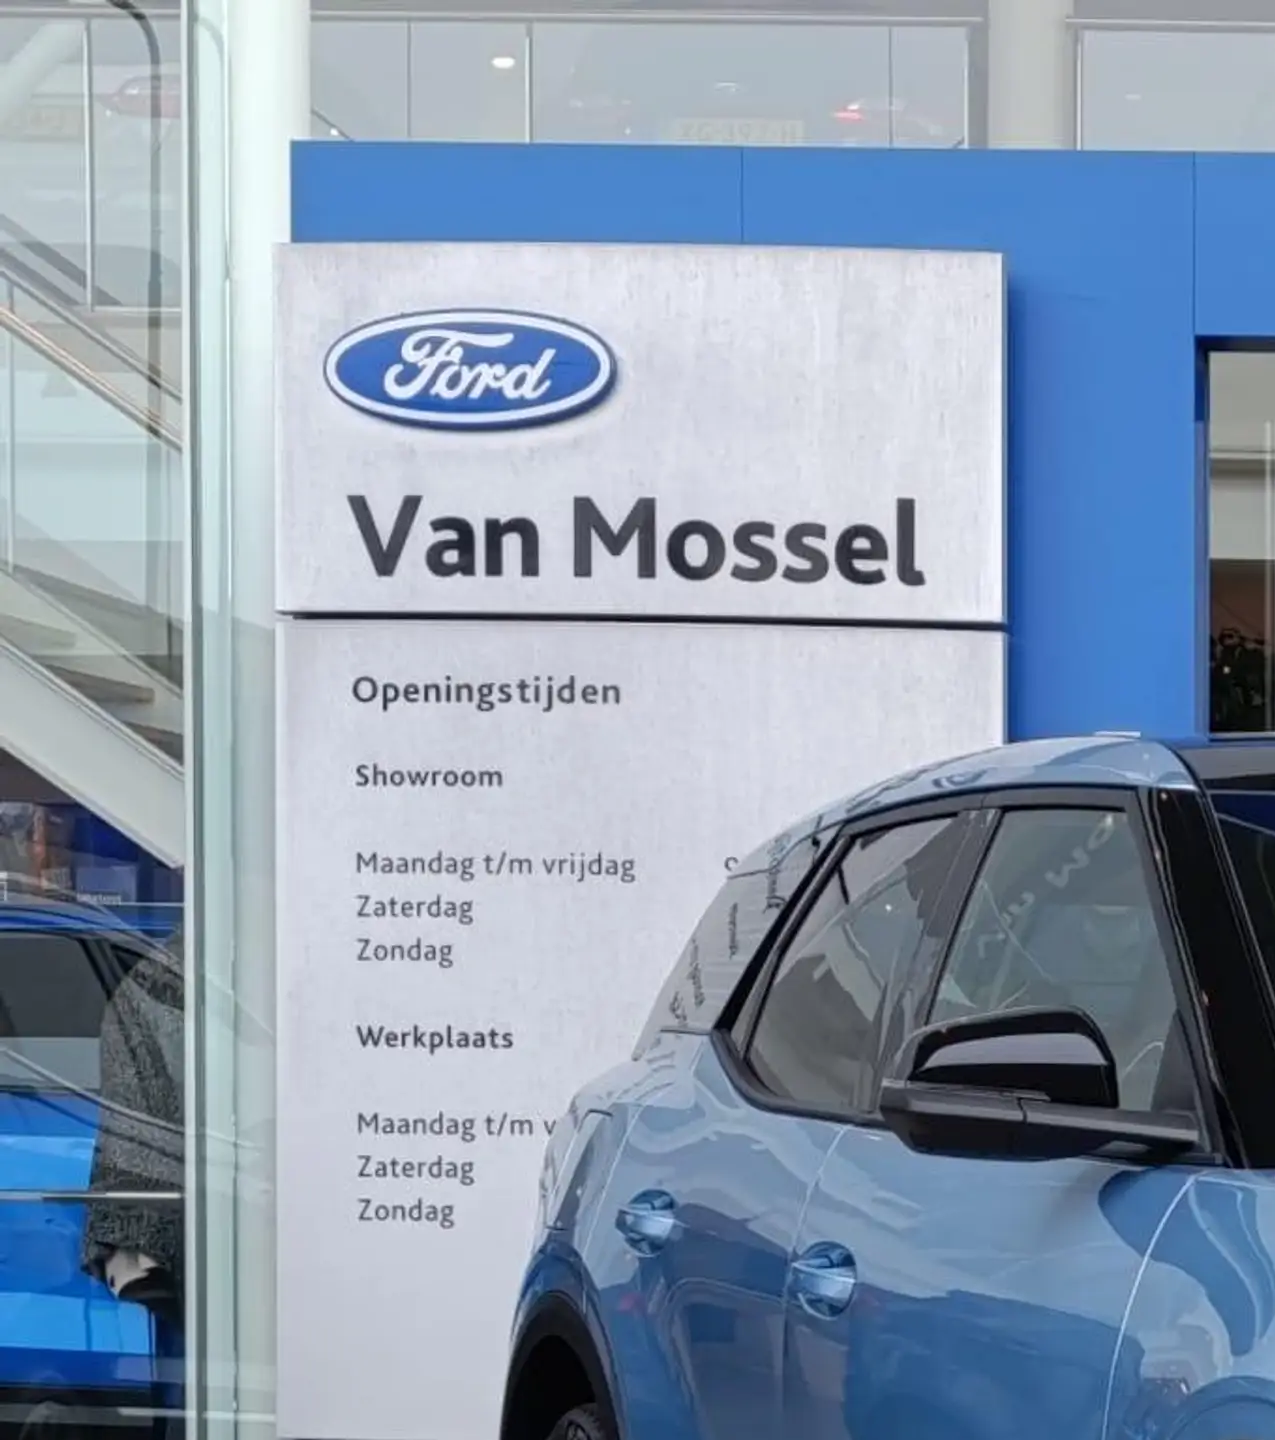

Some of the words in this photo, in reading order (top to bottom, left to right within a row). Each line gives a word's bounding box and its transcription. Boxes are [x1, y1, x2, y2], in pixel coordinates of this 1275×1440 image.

[382, 328, 557, 402] Ford
[348, 495, 539, 578] Van
[573, 496, 926, 587] Mossel
[352, 675, 622, 713] Openingstijden
[355, 764, 503, 788] Showroom
[356, 851, 475, 882] Maandag
[483, 851, 533, 876] t/m
[542, 852, 637, 884] vrijdag
[356, 894, 475, 926] Zaterdag
[356, 937, 454, 969] Zondag
[356, 1024, 514, 1056] Werkplaats
[357, 1112, 477, 1144] Maandag
[484, 1112, 534, 1137] t/m
[357, 1154, 475, 1187] Zaterdag
[357, 1198, 455, 1230] Zondag
